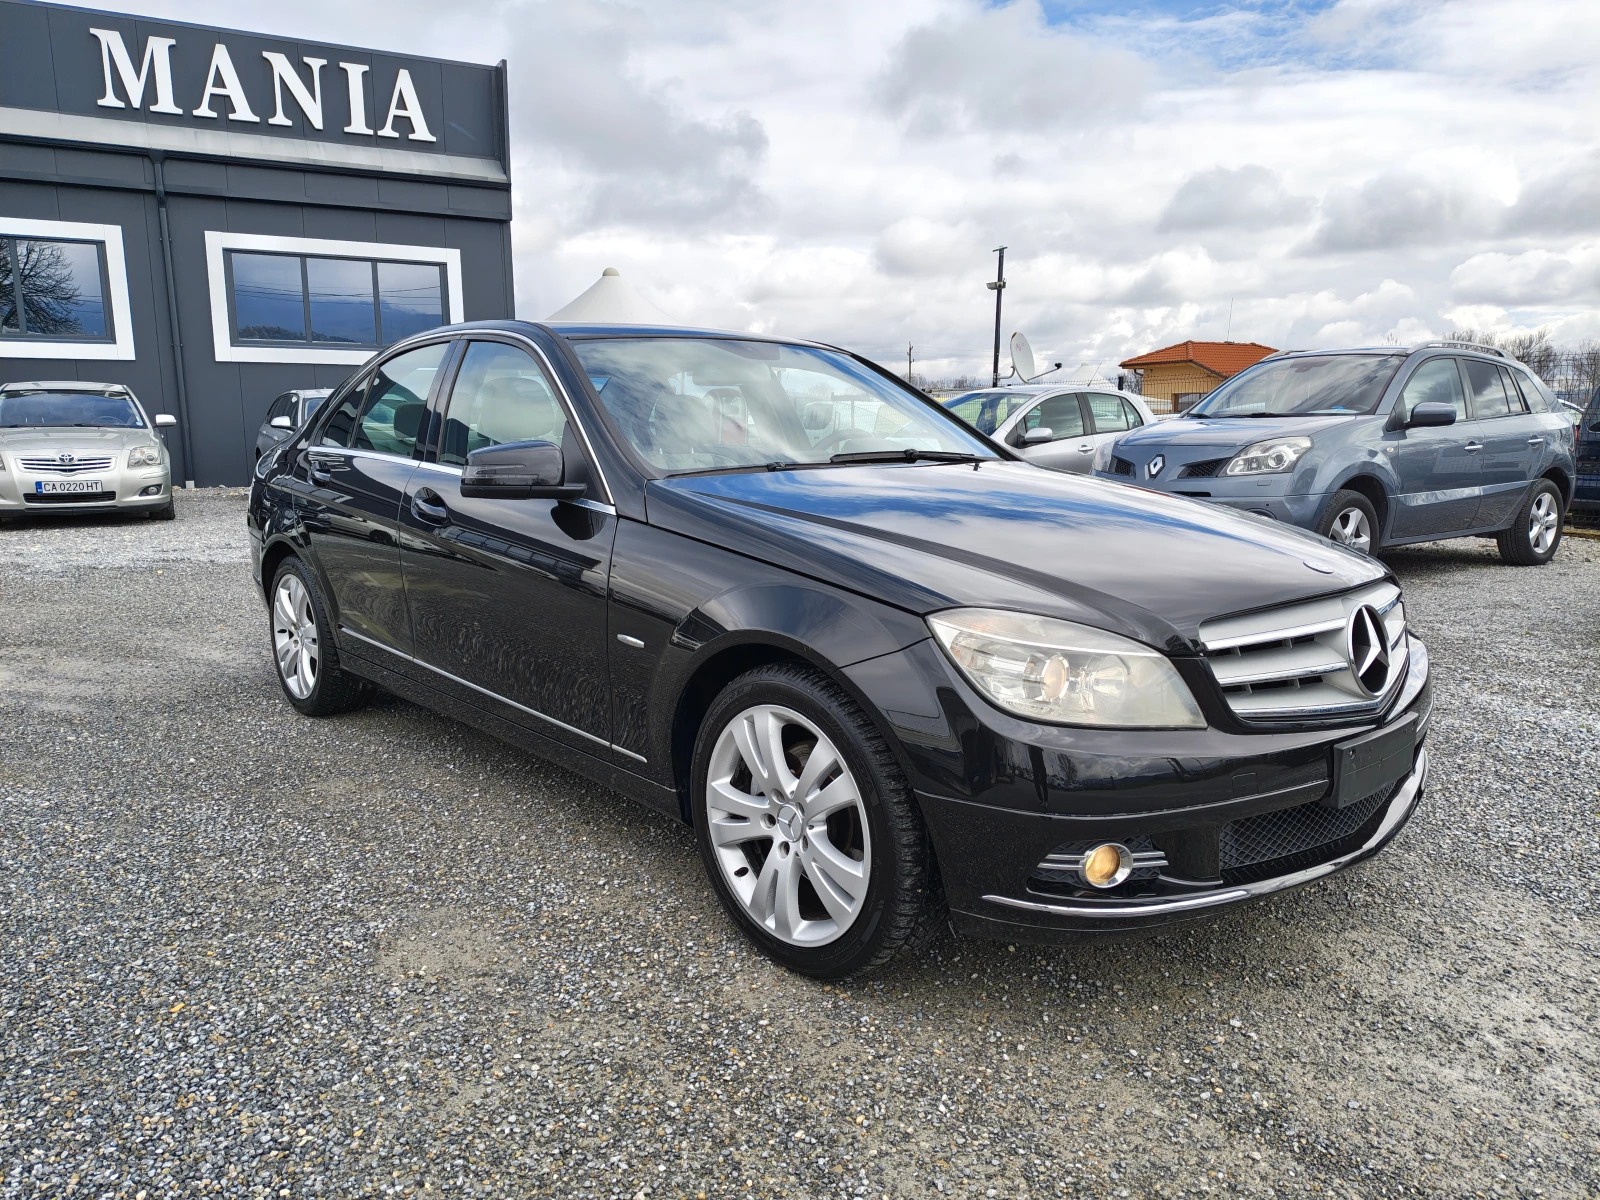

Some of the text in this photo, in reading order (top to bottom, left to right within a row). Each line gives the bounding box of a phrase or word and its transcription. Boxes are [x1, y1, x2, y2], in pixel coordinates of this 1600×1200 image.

[89, 27, 437, 142] MANIA
[43, 481, 100, 492] CA 0220 HT
